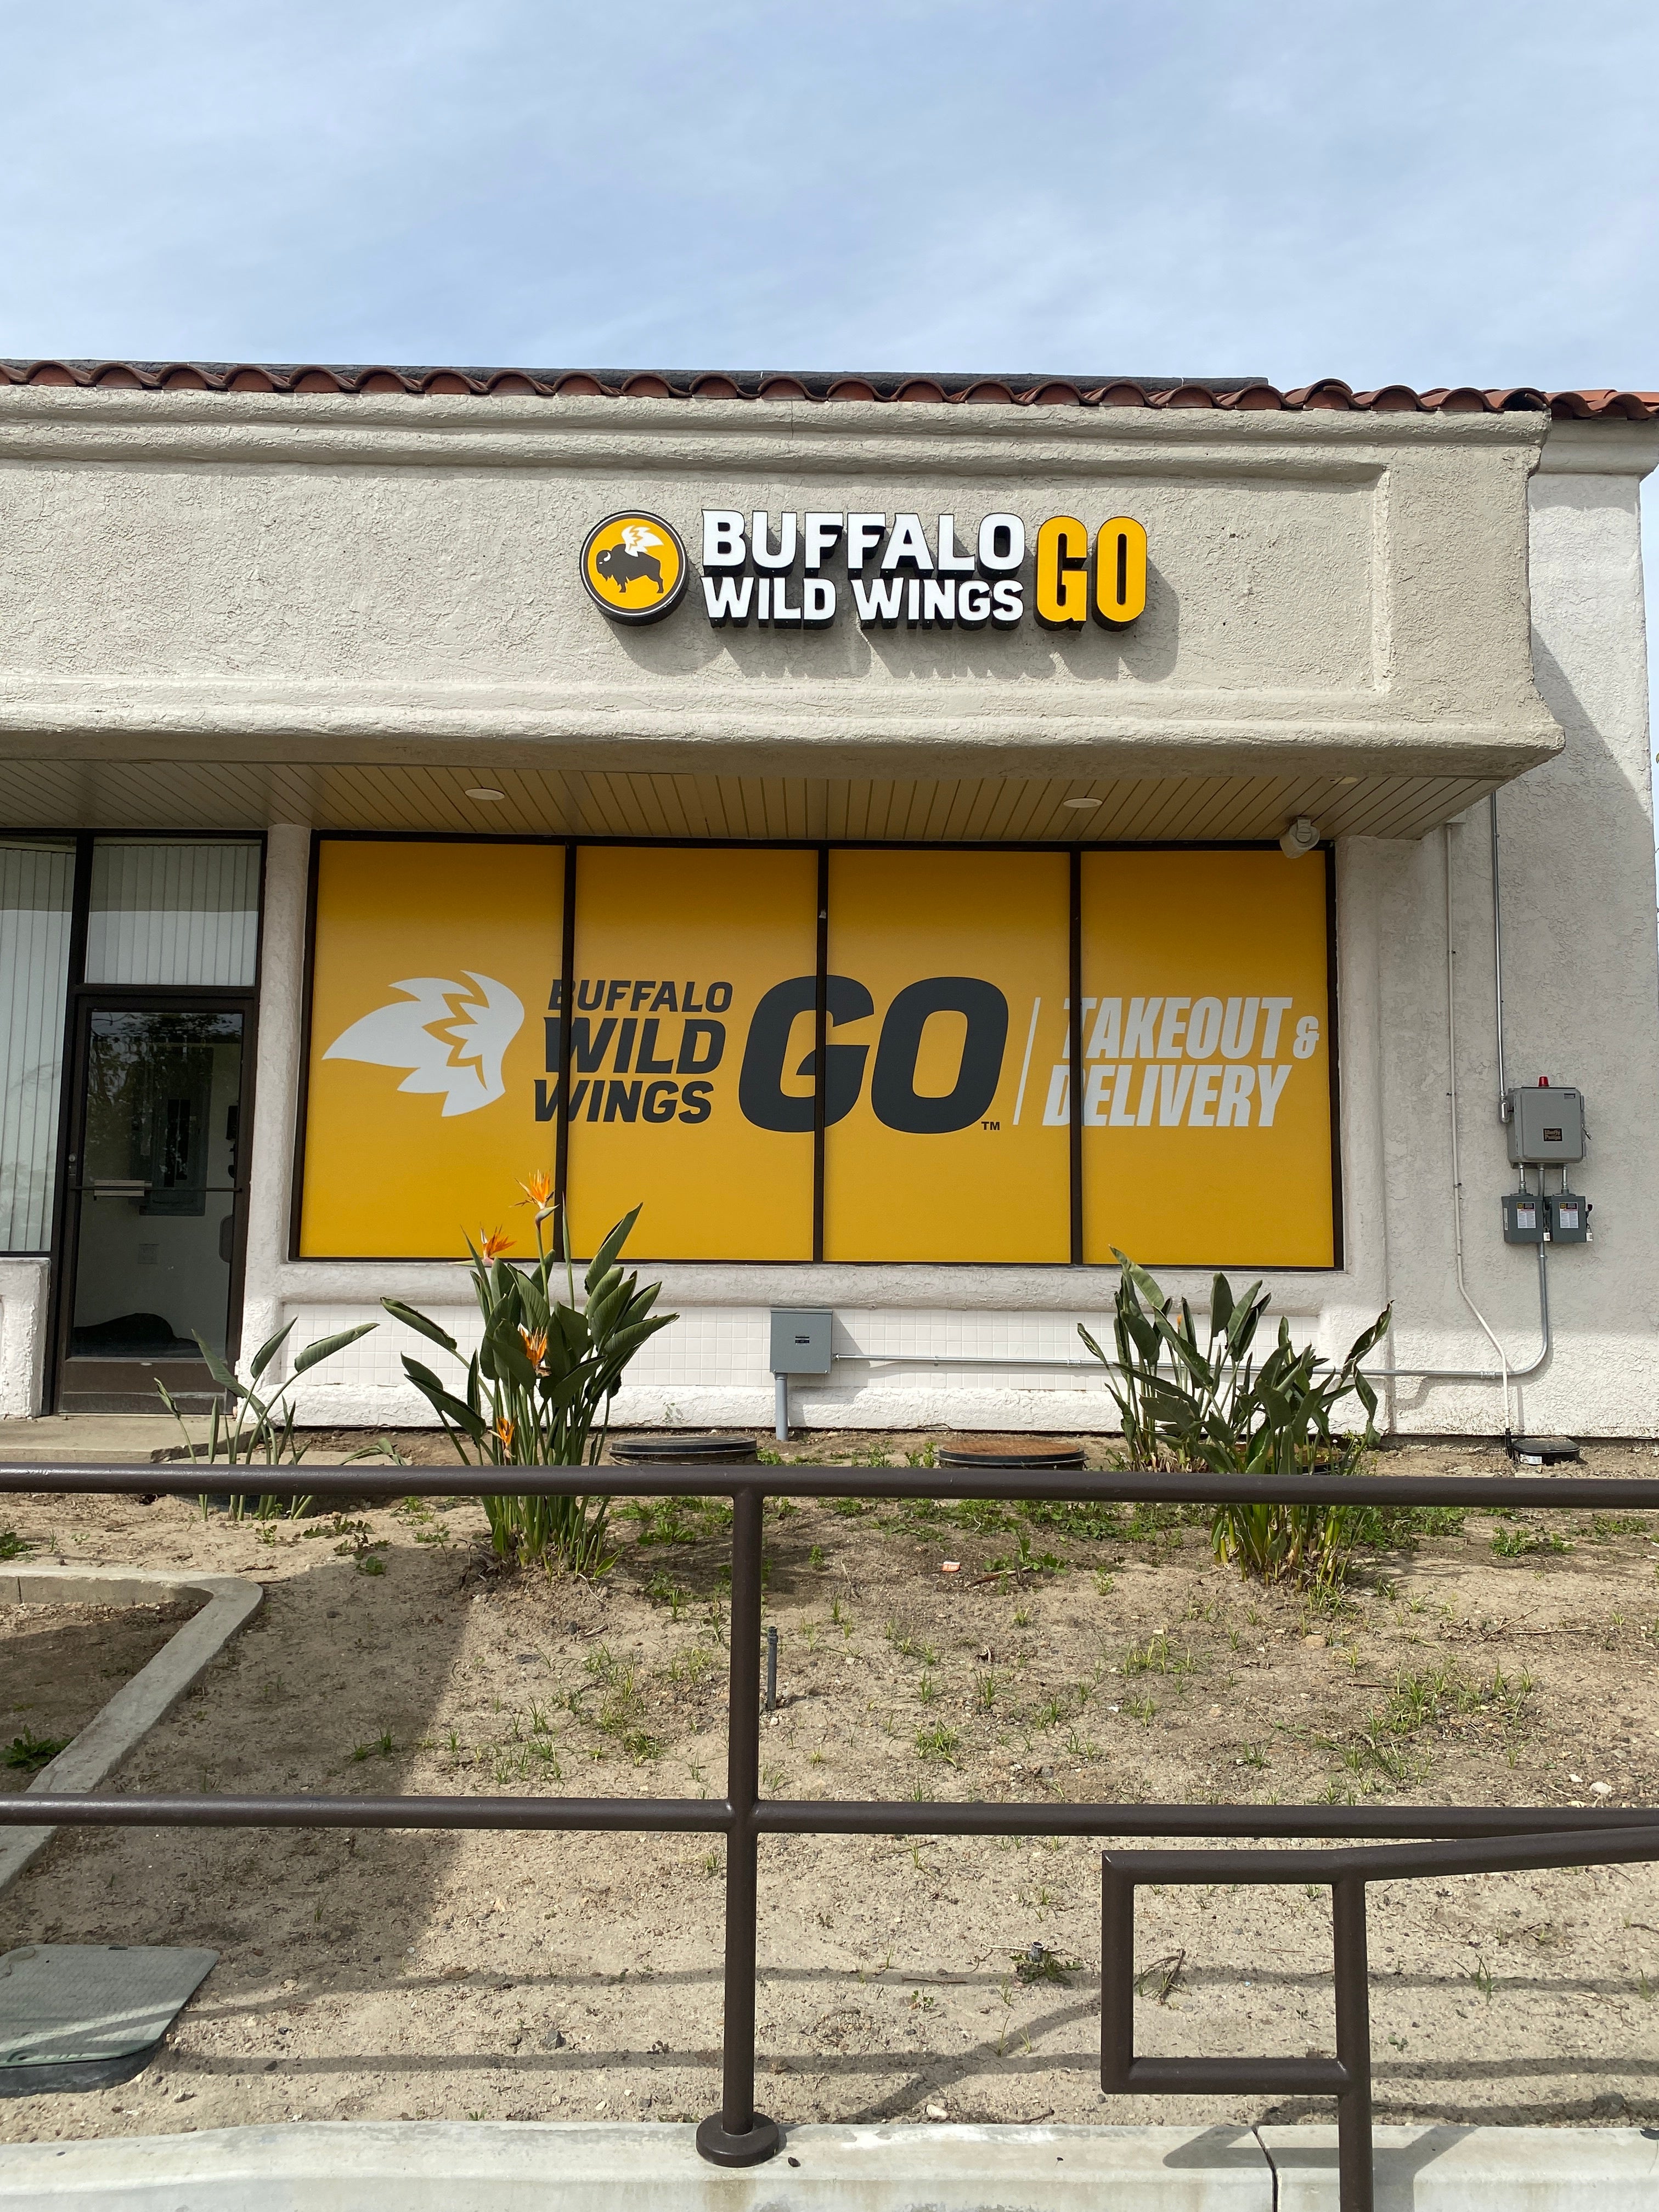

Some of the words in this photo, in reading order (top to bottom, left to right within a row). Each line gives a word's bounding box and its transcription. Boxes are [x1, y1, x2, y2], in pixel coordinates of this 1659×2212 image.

[702, 510, 1025, 573] BUFFALO
[1035, 516, 1147, 623] GO
[702, 577, 837, 620] WILD
[853, 577, 1024, 621] WINGS
[548, 979, 733, 1013] BUFFALO
[544, 1017, 726, 1074] WILD
[739, 975, 1008, 1133] GO
[1062, 997, 1292, 1059] TAKEOUT
[1293, 1016, 1319, 1059] &
[534, 1080, 714, 1124] WINGS
[1042, 1065, 1292, 1127] DELIVERY
[981, 1121, 1000, 1131] TM
